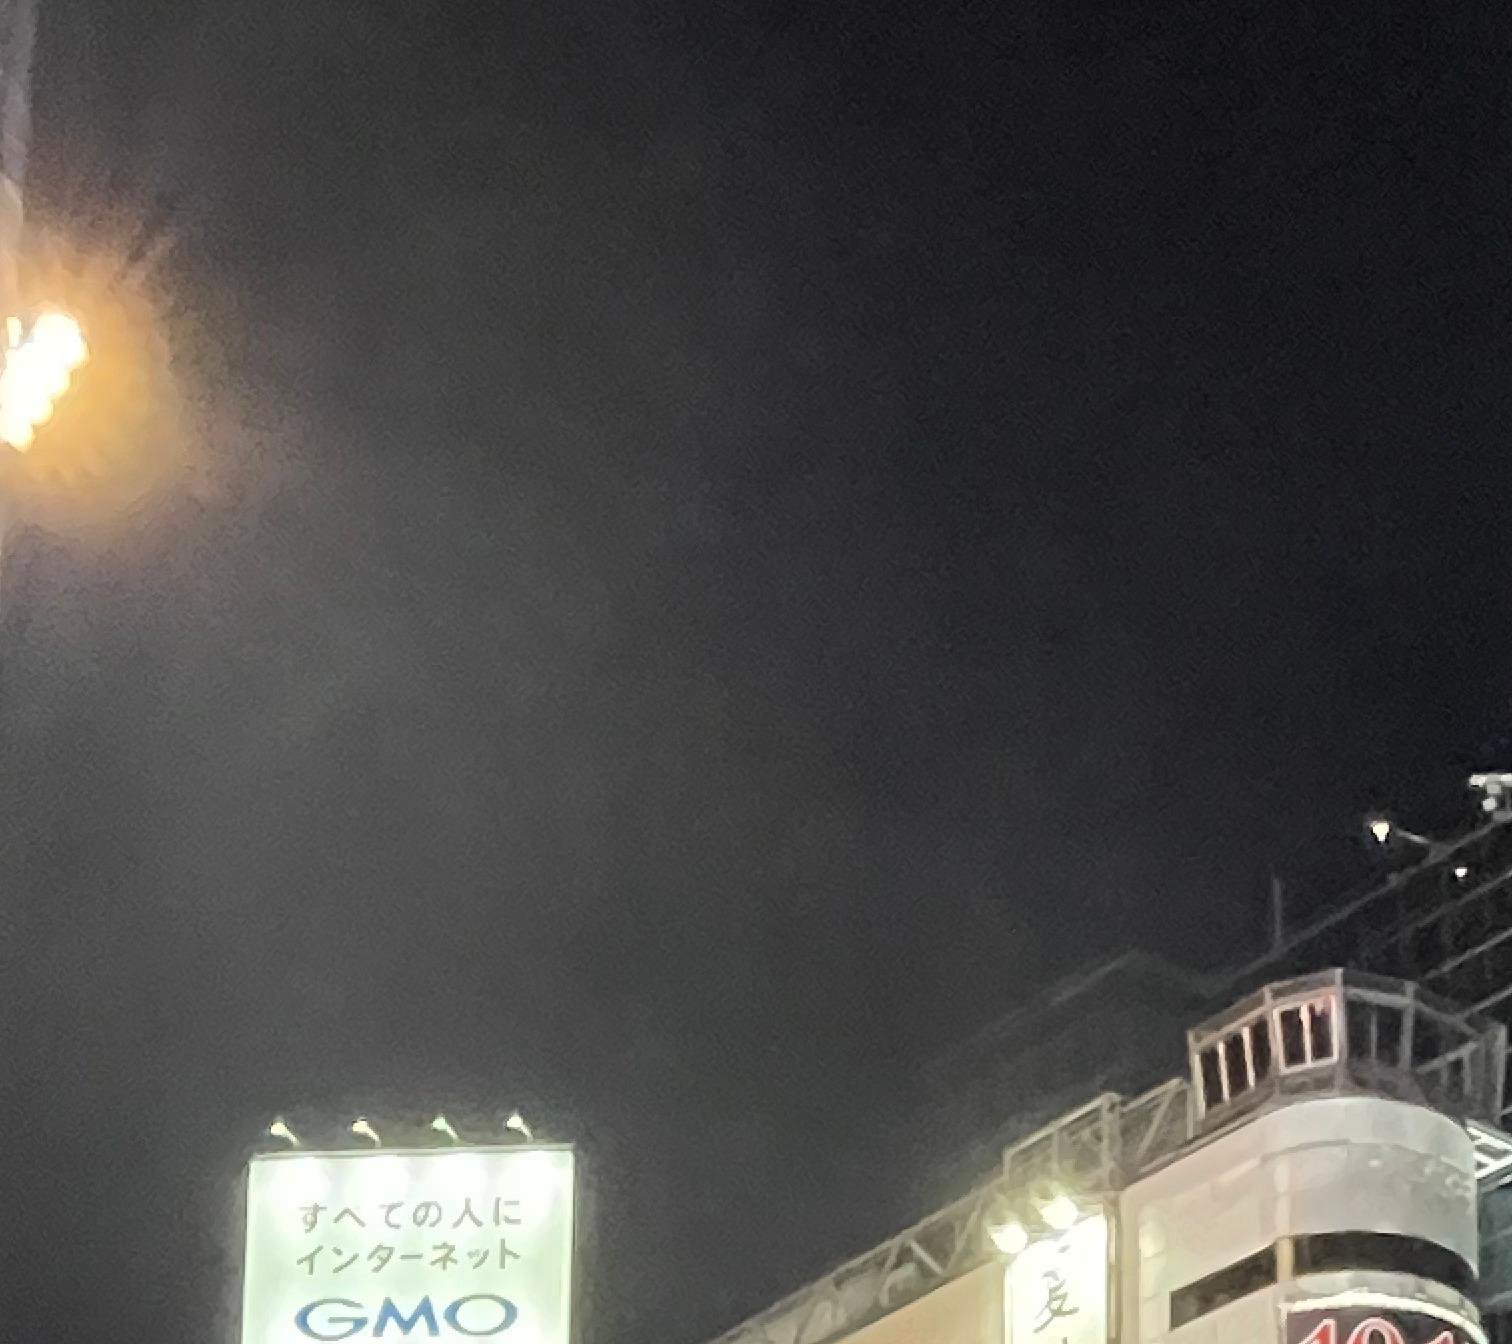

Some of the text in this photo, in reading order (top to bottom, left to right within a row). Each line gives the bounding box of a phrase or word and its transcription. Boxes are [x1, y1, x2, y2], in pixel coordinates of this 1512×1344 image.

[296, 1239, 521, 1275] インターネット
[294, 1294, 519, 1341] GMO
